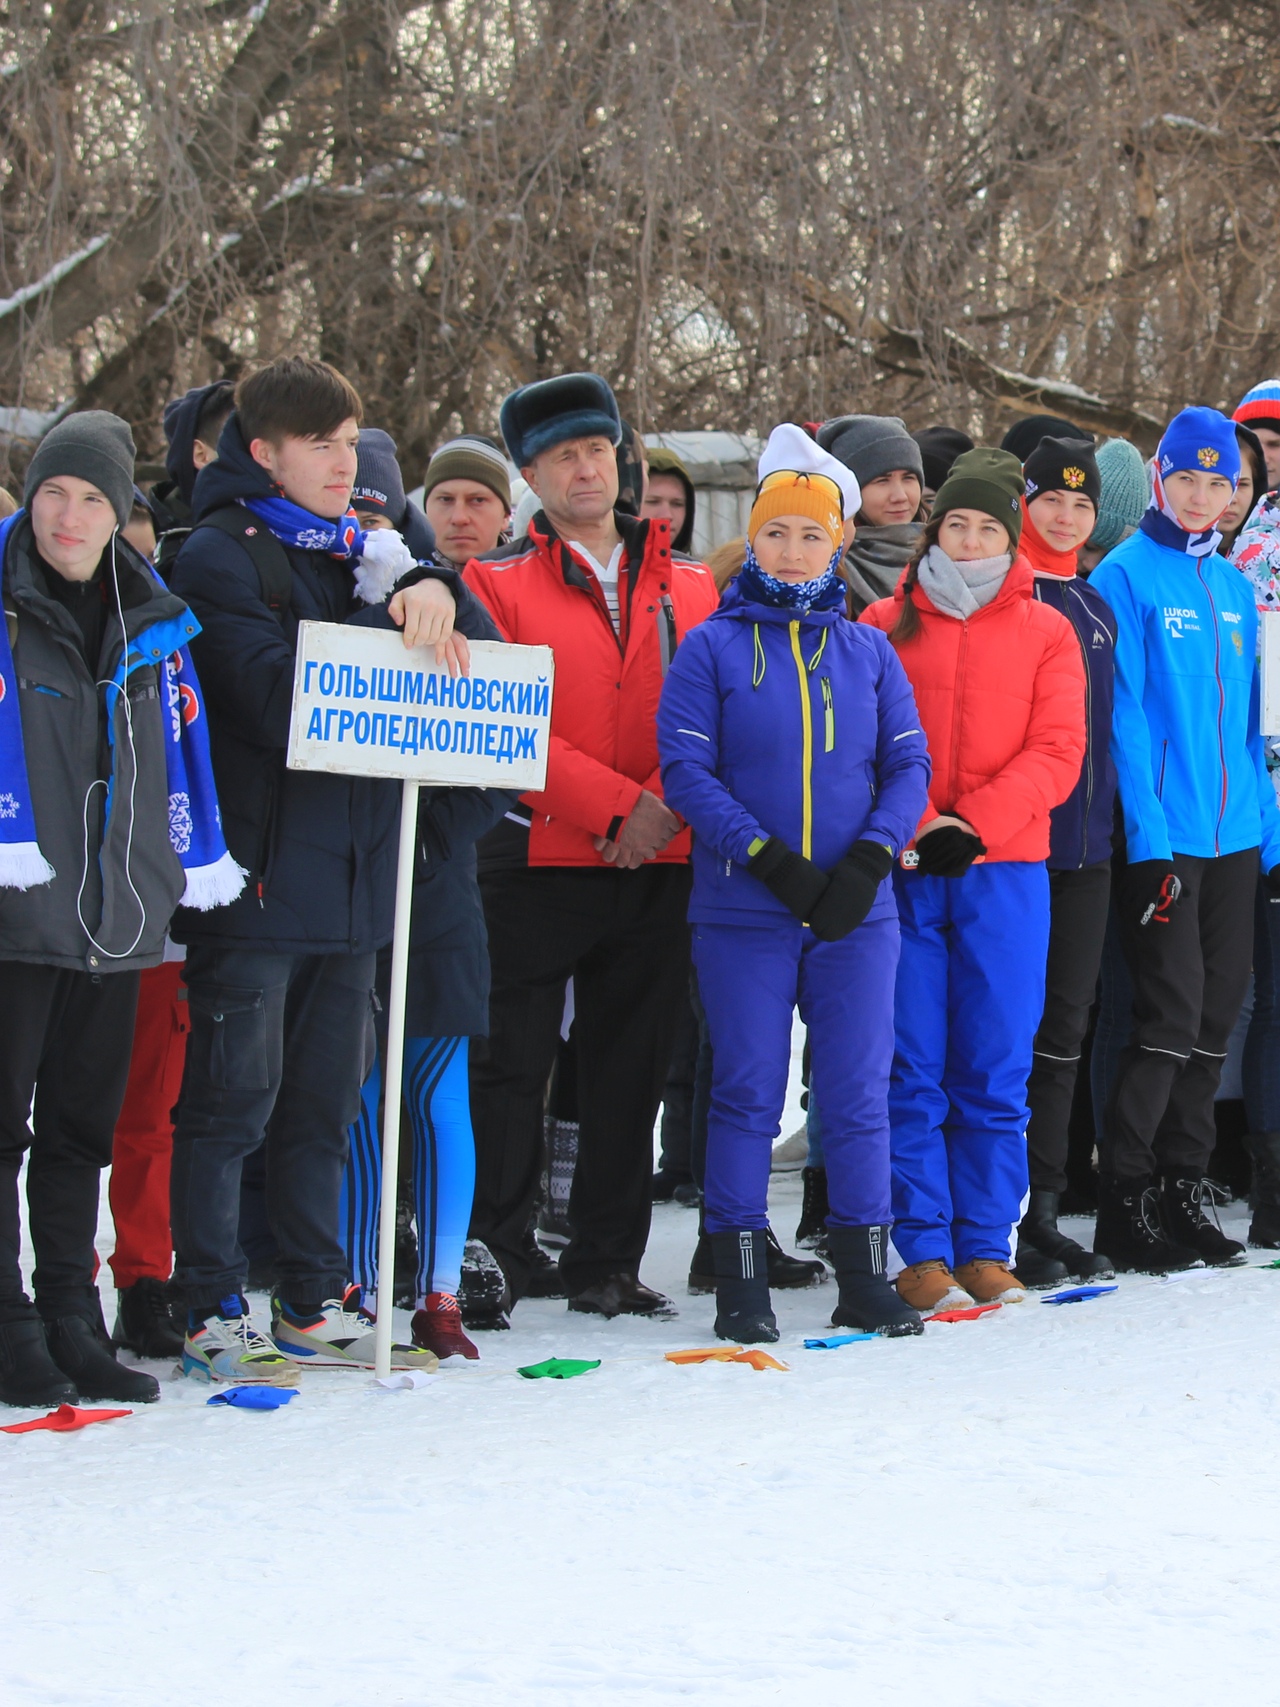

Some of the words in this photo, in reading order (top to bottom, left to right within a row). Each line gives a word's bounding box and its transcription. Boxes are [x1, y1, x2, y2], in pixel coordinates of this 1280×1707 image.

[1164, 607, 1198, 619] LUKOIL
[304, 661, 549, 717] ГОЛЫШМАНОВСКИЙ
[307, 707, 539, 764] АГРОПЕДКОЛЛЕДЖ
